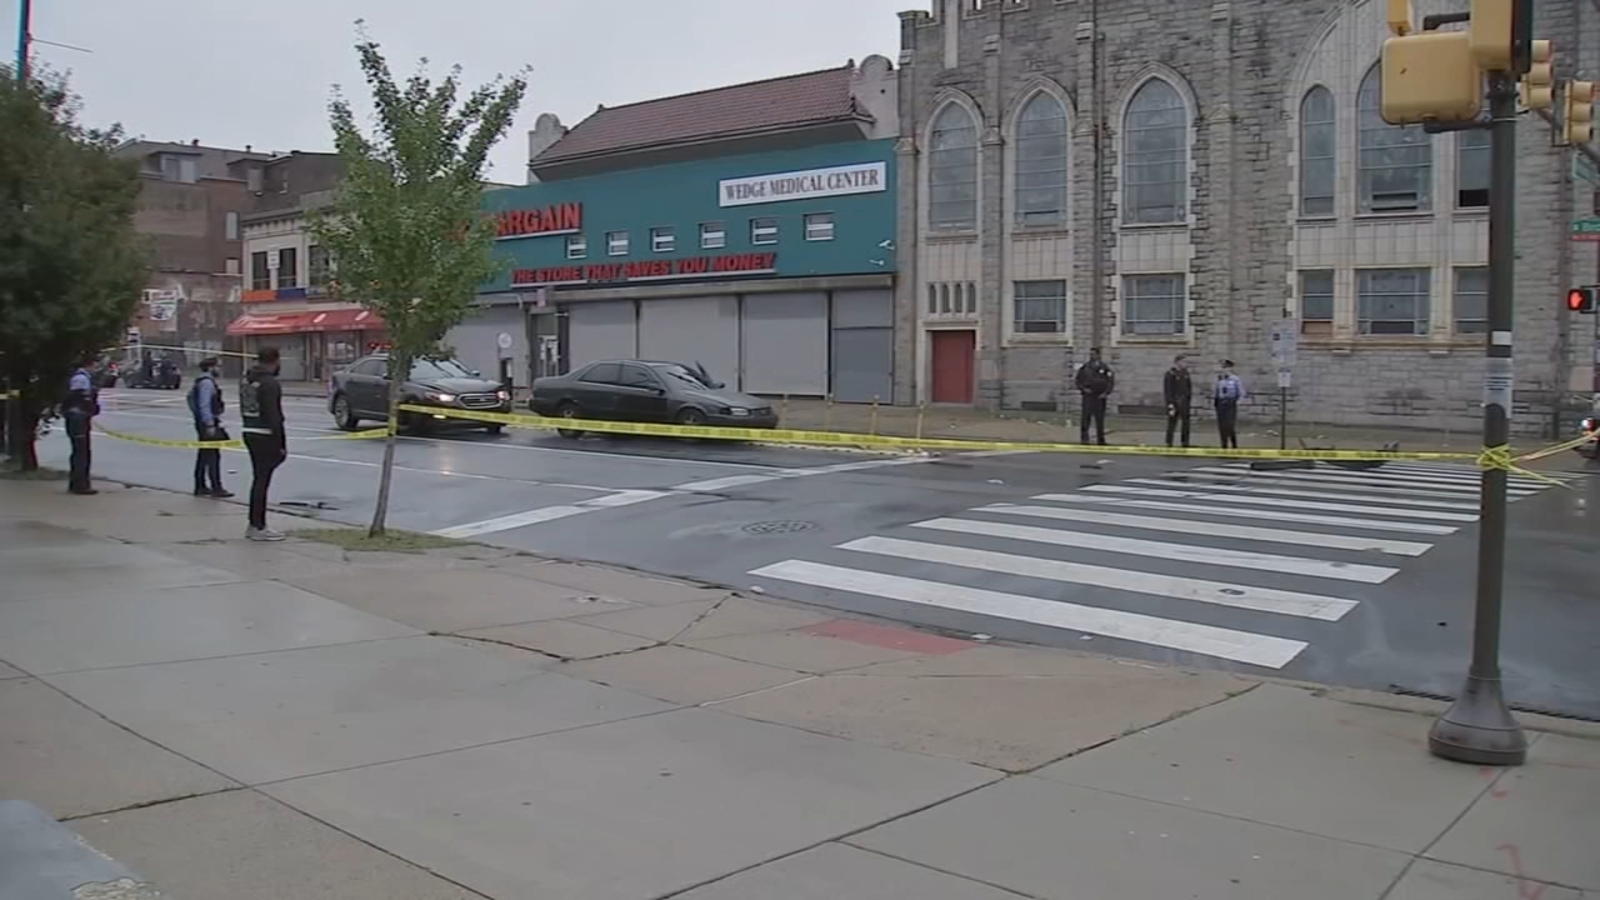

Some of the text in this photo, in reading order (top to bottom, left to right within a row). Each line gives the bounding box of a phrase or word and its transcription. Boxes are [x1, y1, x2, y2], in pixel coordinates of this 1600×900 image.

[725, 168, 879, 200] WEDGE MEDICAL CENTER
[481, 202, 581, 238] ARGAIN
[512, 252, 776, 284] THE STORE THAT SAVES YOU MONEY
